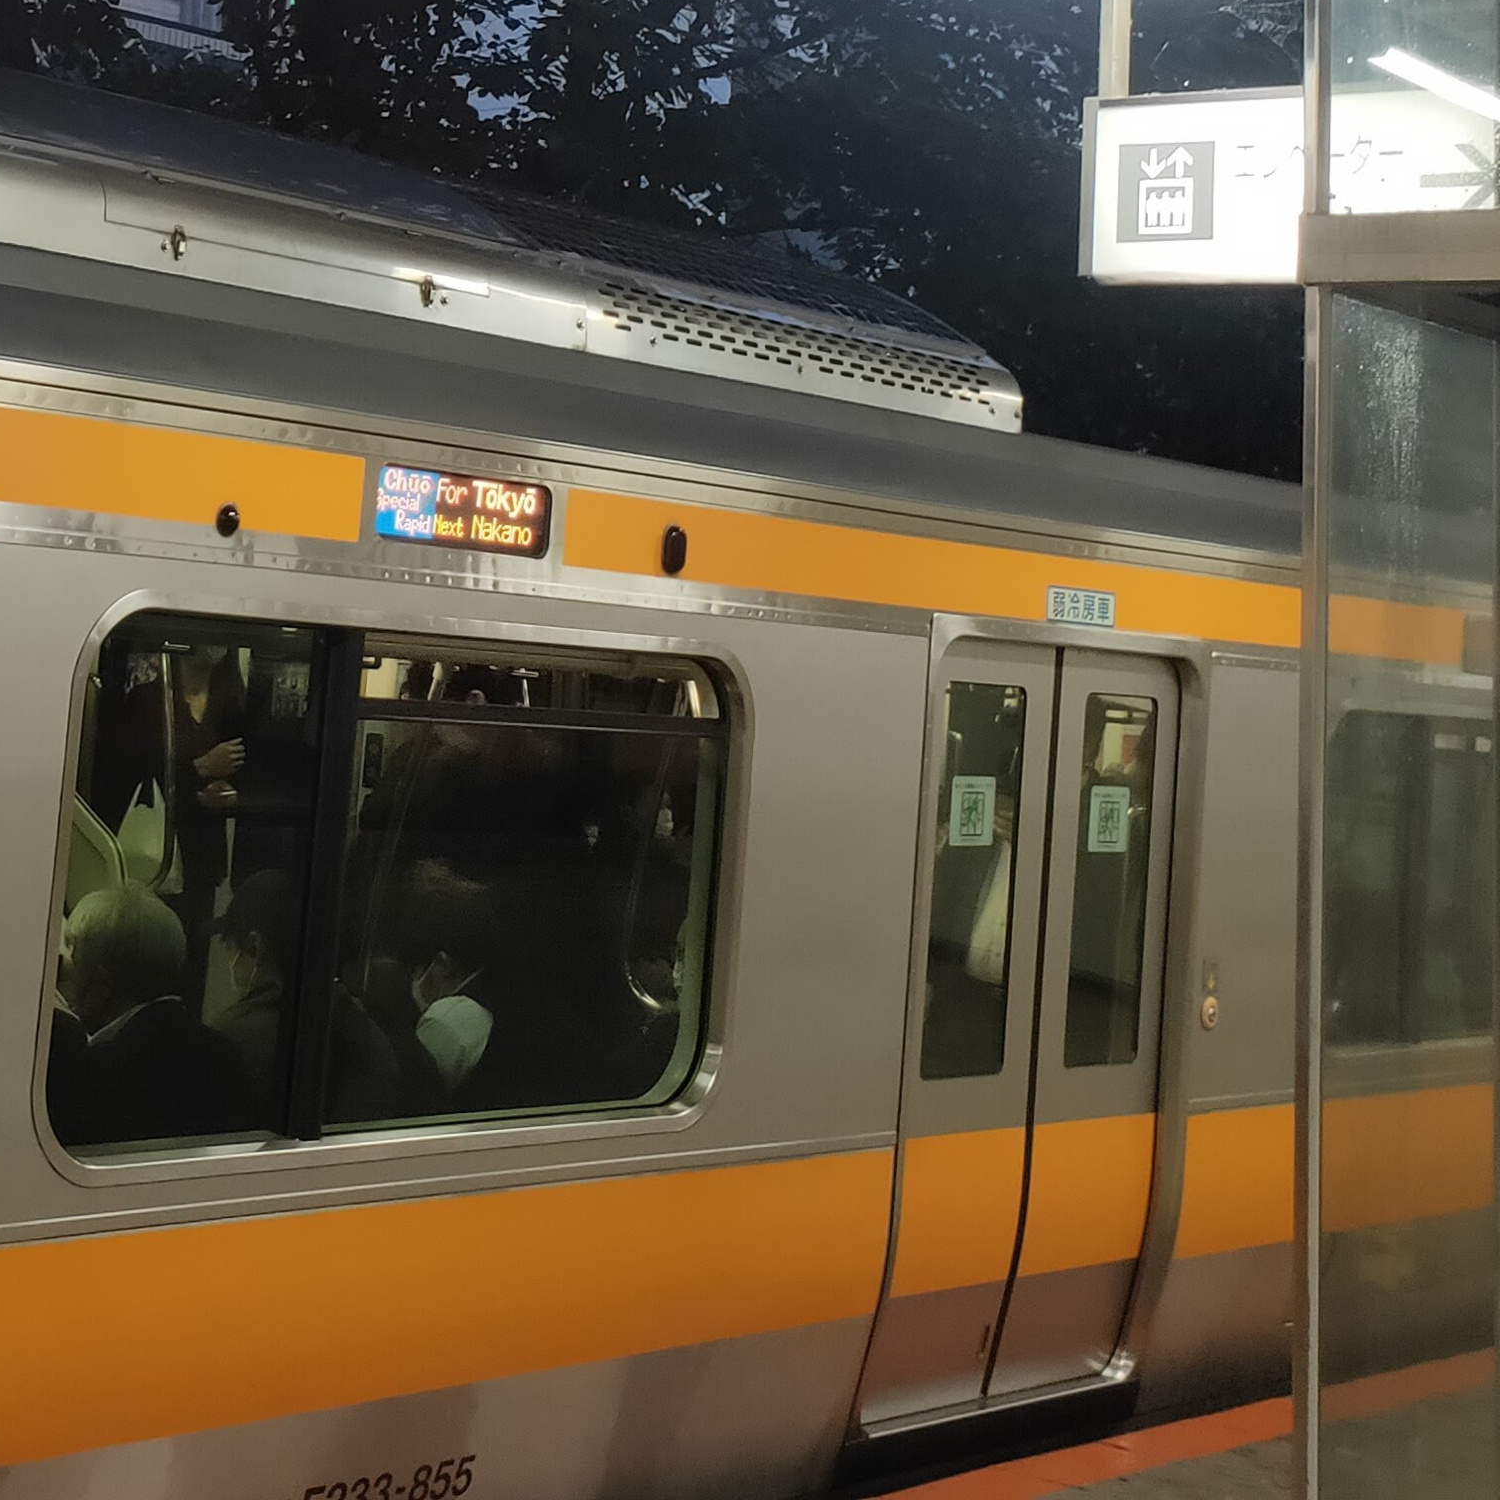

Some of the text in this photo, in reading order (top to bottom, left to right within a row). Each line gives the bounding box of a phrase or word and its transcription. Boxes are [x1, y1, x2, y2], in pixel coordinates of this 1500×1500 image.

[394, 511, 431, 536] Rapid
[433, 514, 533, 546] Next Nakano
[1052, 591, 1111, 623] 弱冷房車
